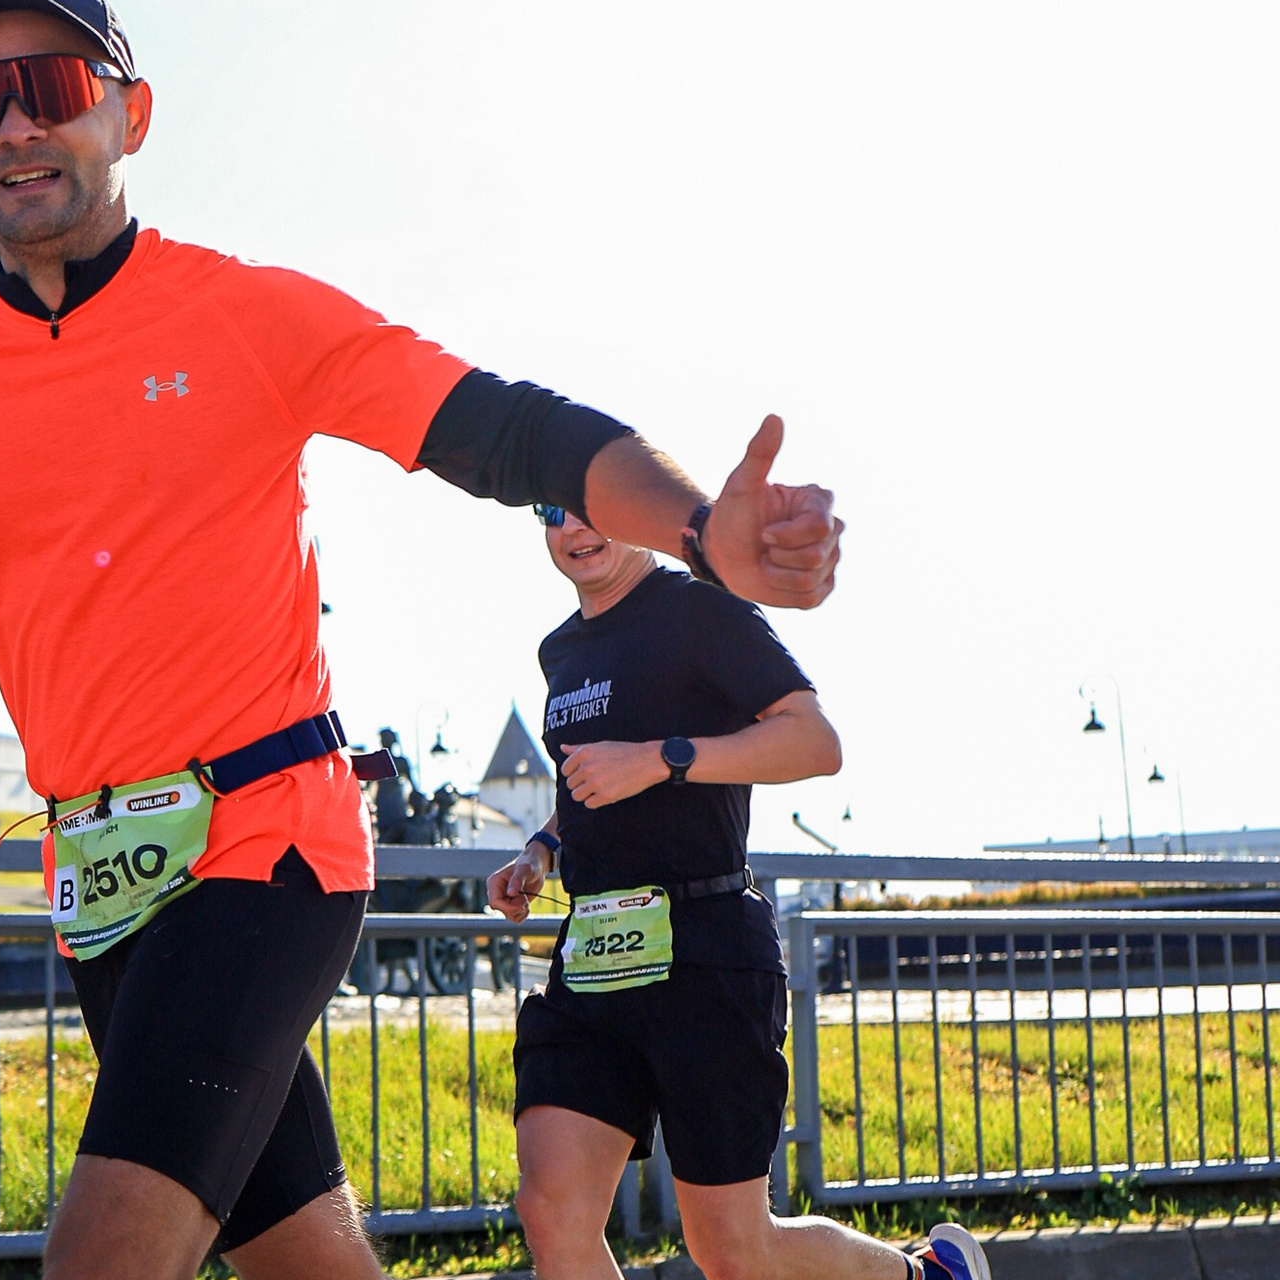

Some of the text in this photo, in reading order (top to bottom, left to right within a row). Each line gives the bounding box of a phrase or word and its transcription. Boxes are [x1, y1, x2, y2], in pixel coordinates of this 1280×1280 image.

[548, 678, 612, 714] IRONMAN
[571, 697, 609, 723] TURKEY
[130, 795, 170, 810] WINLINE
[82, 844, 168, 906] 2510
[59, 879, 74, 912] B
[621, 898, 643, 907] WINLINE
